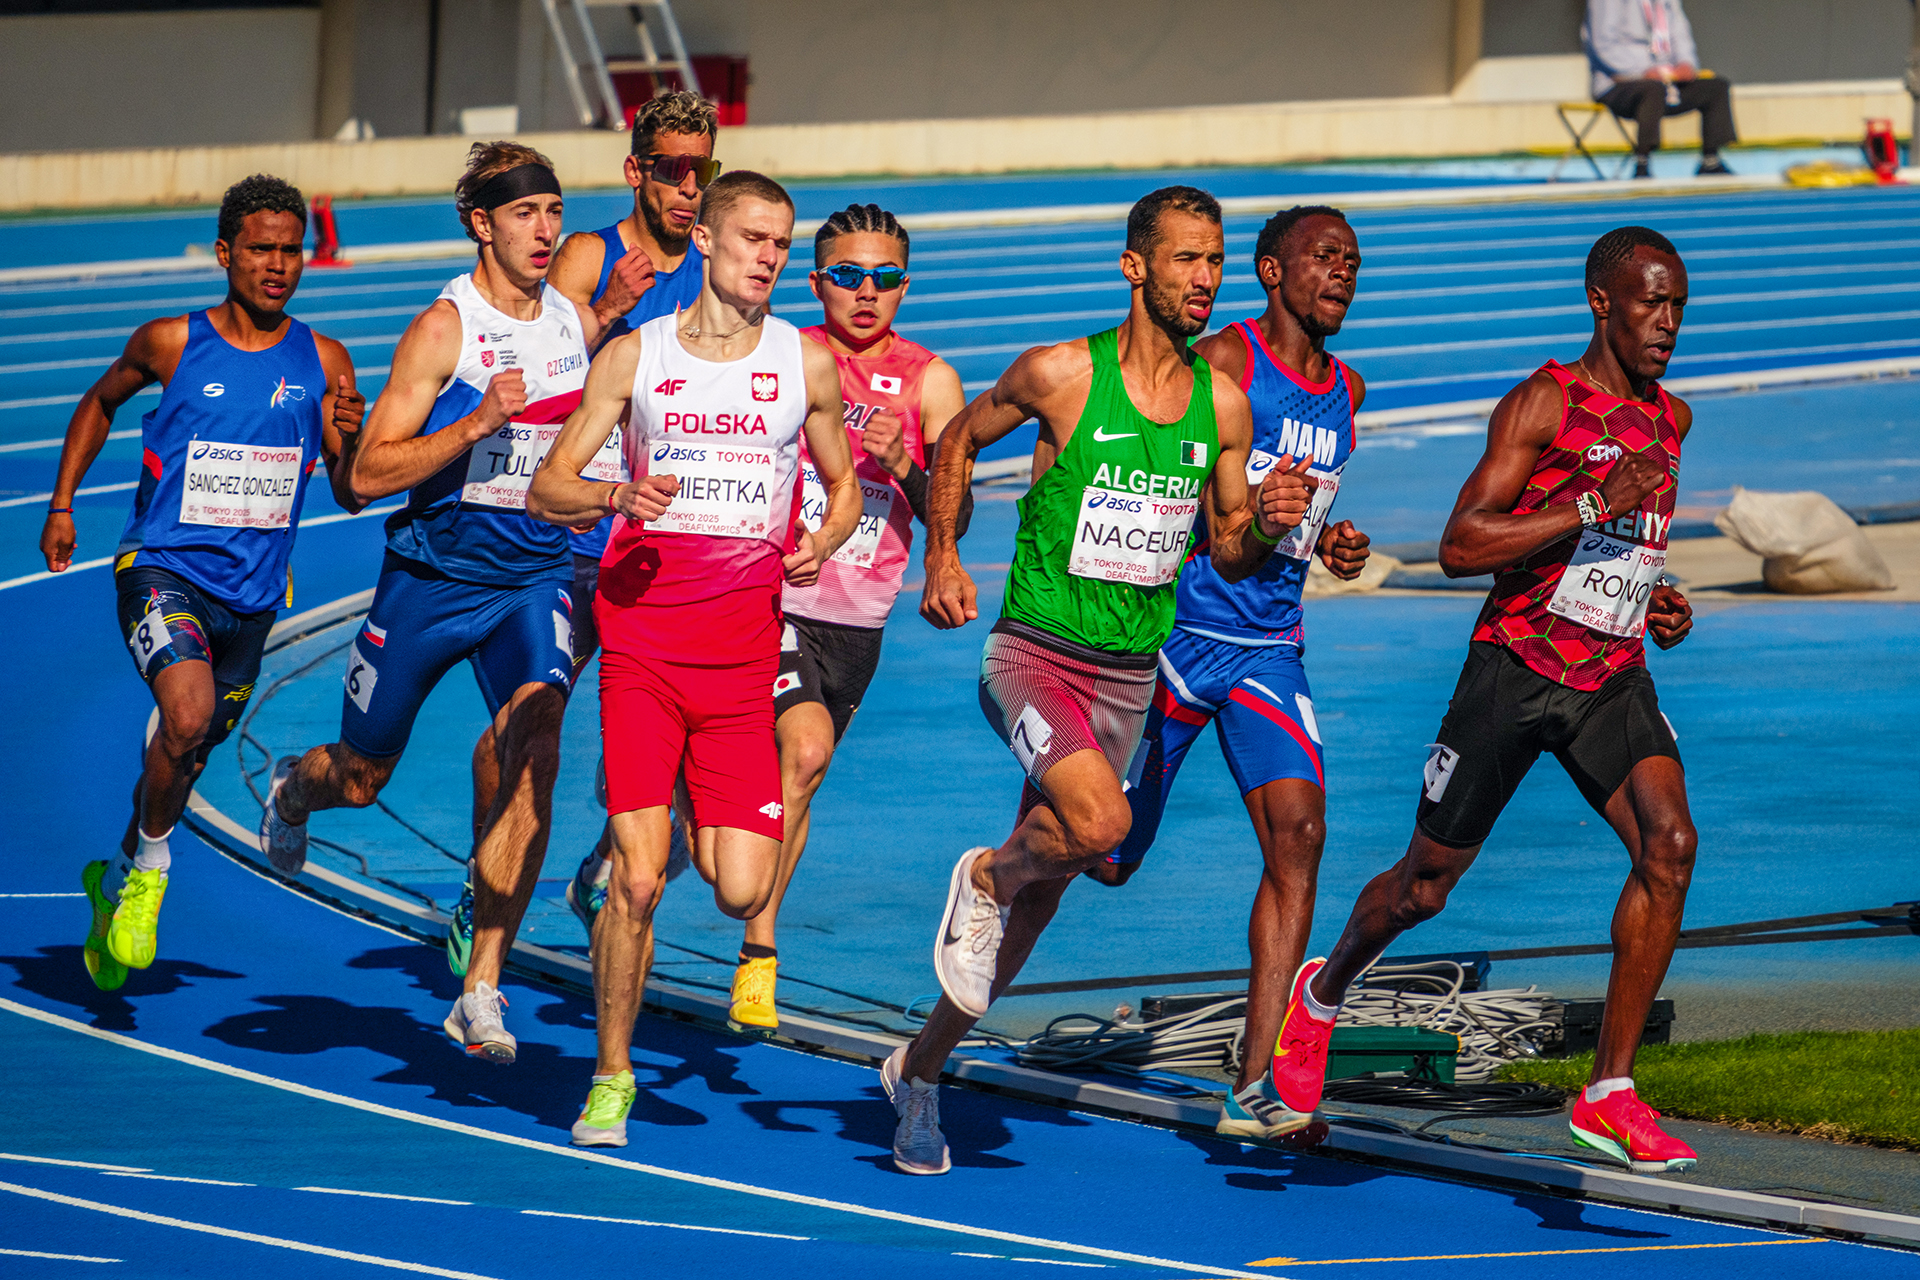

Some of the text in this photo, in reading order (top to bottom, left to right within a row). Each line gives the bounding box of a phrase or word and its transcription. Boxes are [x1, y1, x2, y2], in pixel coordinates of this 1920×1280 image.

[546, 353, 584, 378] CZECHIA
[654, 378, 688, 396] 4F
[664, 412, 767, 436] POLSKA
[498, 427, 532, 441] asics
[1277, 417, 1338, 467] NAM
[209, 447, 298, 463] asics TOYOTA
[670, 448, 771, 465] asics TOYOTA
[188, 472, 294, 497] SANCHEZ GONZALEZ
[655, 473, 767, 505] MIERTKA
[1092, 463, 1200, 499] ALGERIA
[486, 486, 513, 497] TOKYO
[202, 505, 250, 517] TOKYO 2025
[1106, 497, 1195, 516] asics TOYOTA
[214, 516, 269, 527] DEAFLYMPICS
[666, 511, 719, 523] TOKYO 2025
[679, 522, 741, 535] DEAFLYMPICS
[1081, 521, 1188, 554] NACEUR
[1600, 542, 1634, 561] asics
[1094, 558, 1123, 570] TOKYO
[1125, 562, 1148, 573] 2025
[1582, 567, 1650, 606] RONO
[1574, 600, 1603, 617] TOKYO
[137, 622, 154, 656] 8
[349, 665, 365, 696] 6
[1014, 719, 1035, 756] 7
